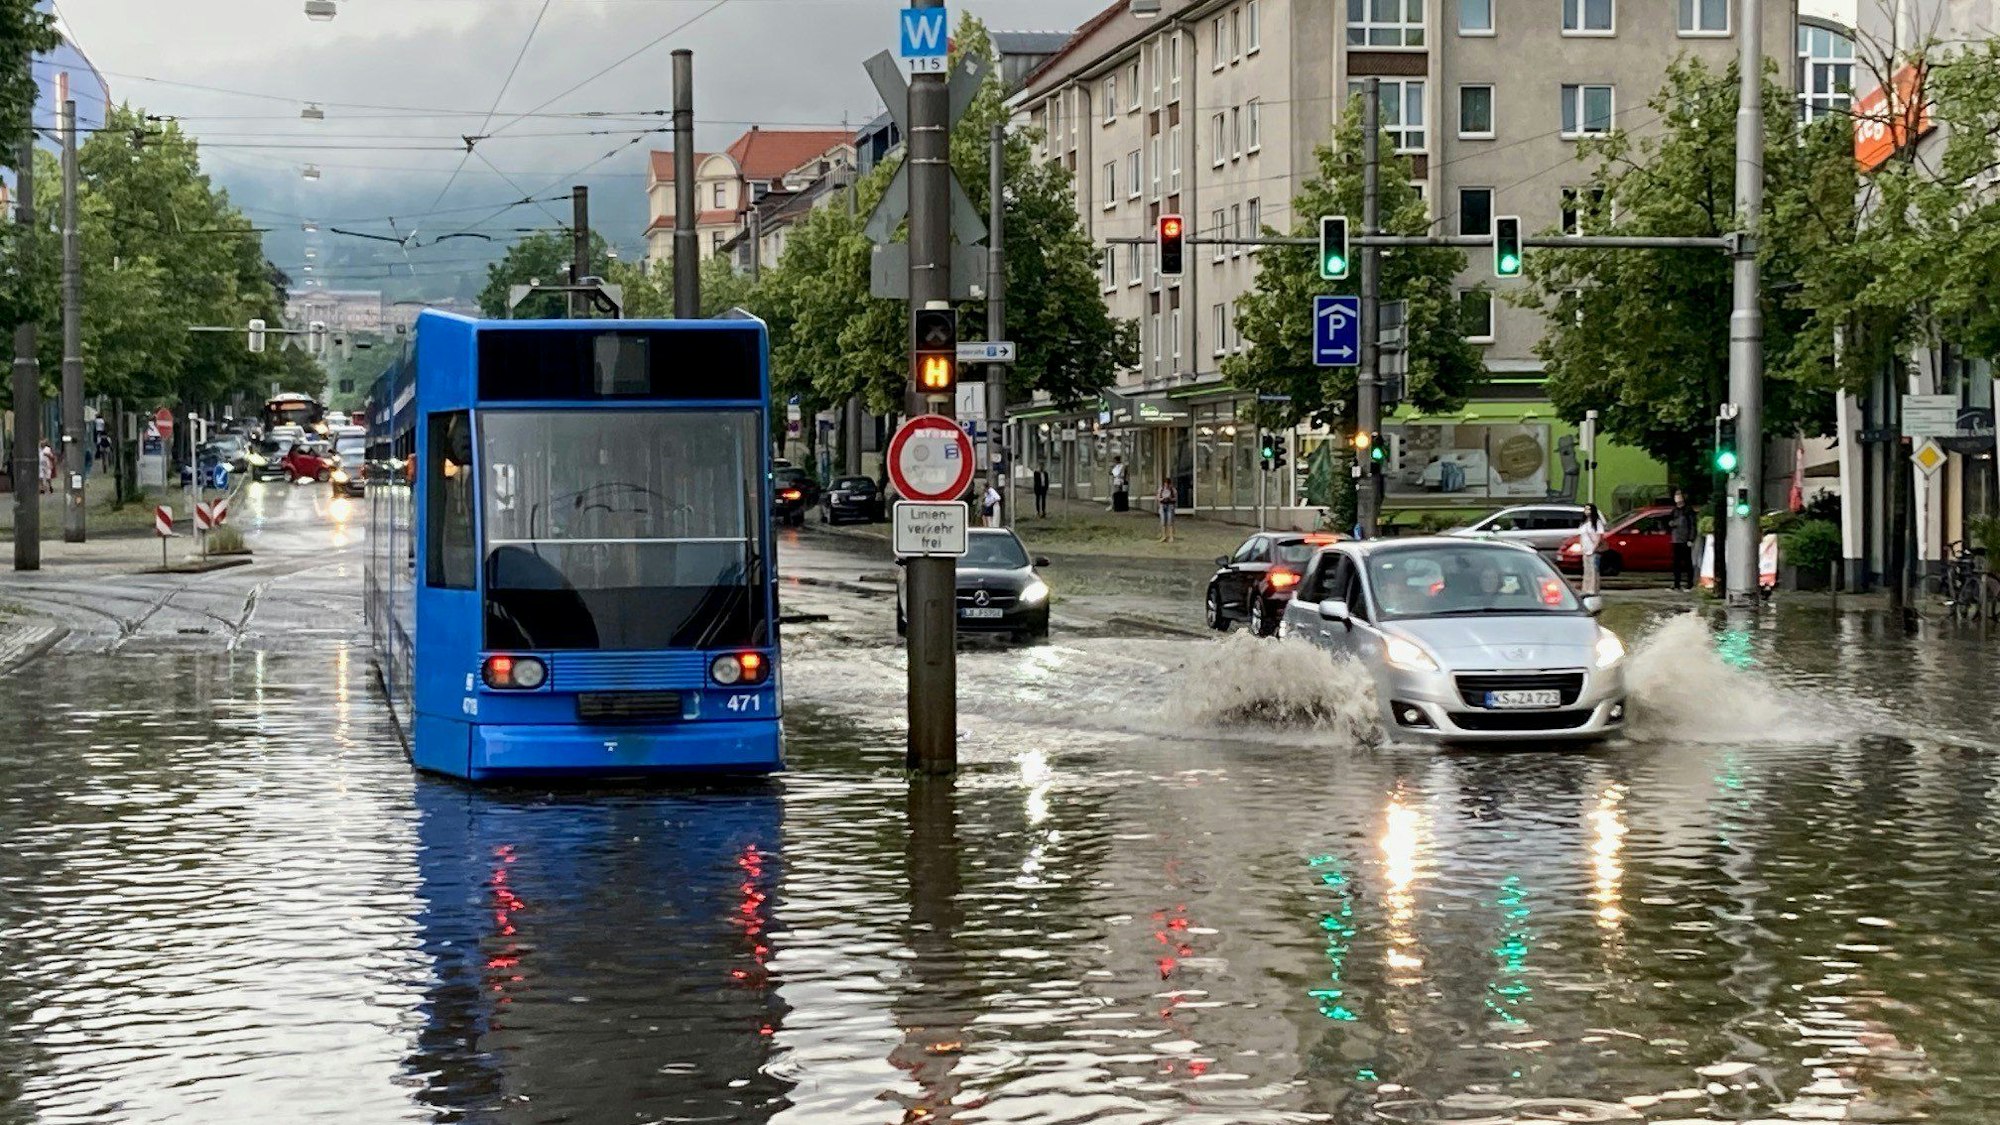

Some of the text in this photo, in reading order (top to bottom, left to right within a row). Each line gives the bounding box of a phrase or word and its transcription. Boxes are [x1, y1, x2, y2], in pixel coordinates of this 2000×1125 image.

[904, 14, 943, 50] W
[909, 58, 940, 71] 115
[1329, 313, 1347, 340] P
[911, 508, 952, 520] Linien-
[908, 522, 954, 534] verkehr
[921, 536, 942, 548] frei
[727, 693, 760, 711] 471
